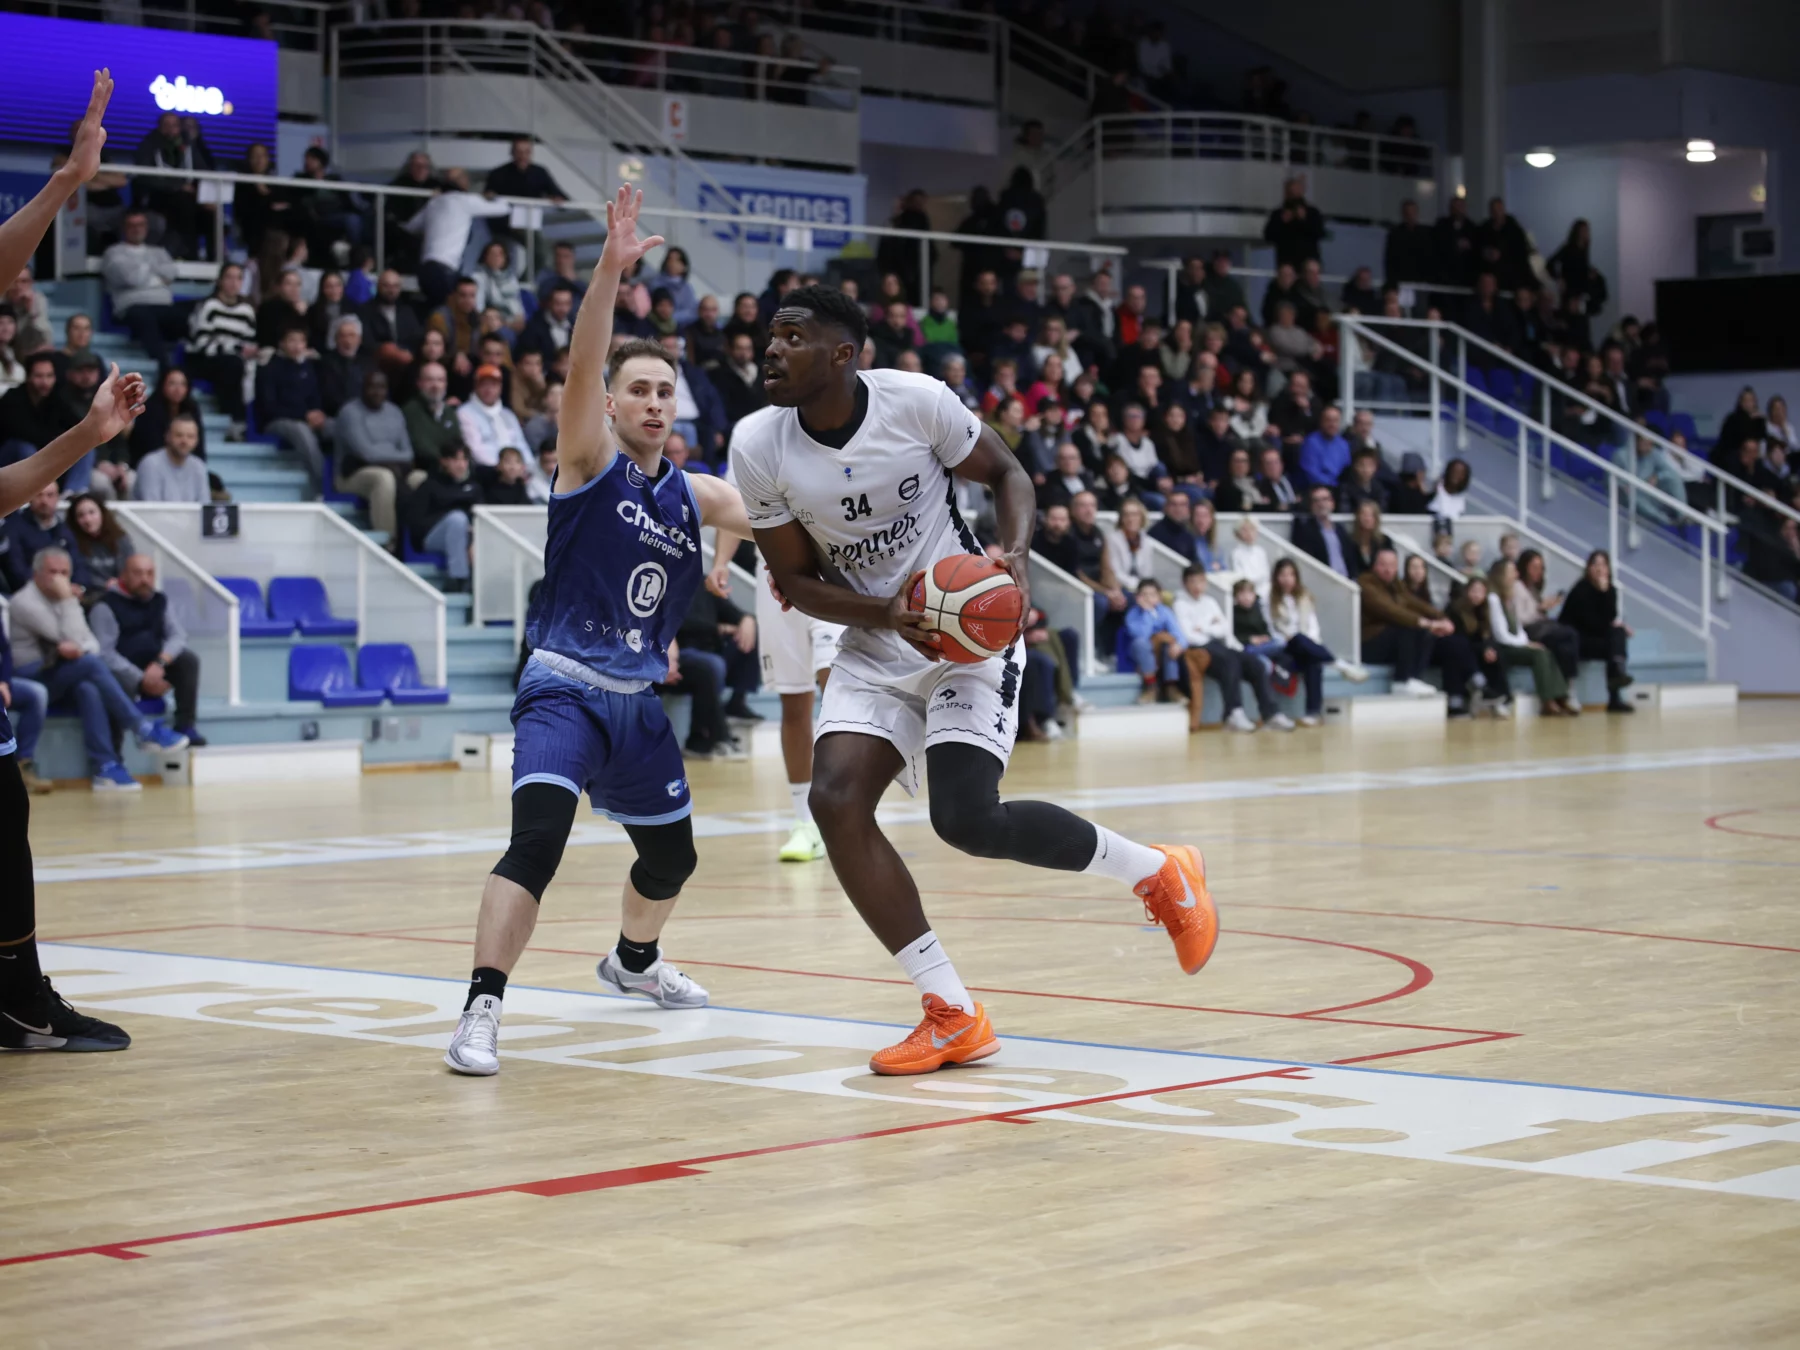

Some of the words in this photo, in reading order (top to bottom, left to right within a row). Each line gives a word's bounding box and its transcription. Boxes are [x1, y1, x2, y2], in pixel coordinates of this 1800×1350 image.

[739, 193, 847, 224] rennes
[841, 493, 873, 522] 34
[638, 530, 684, 560] Métropole
